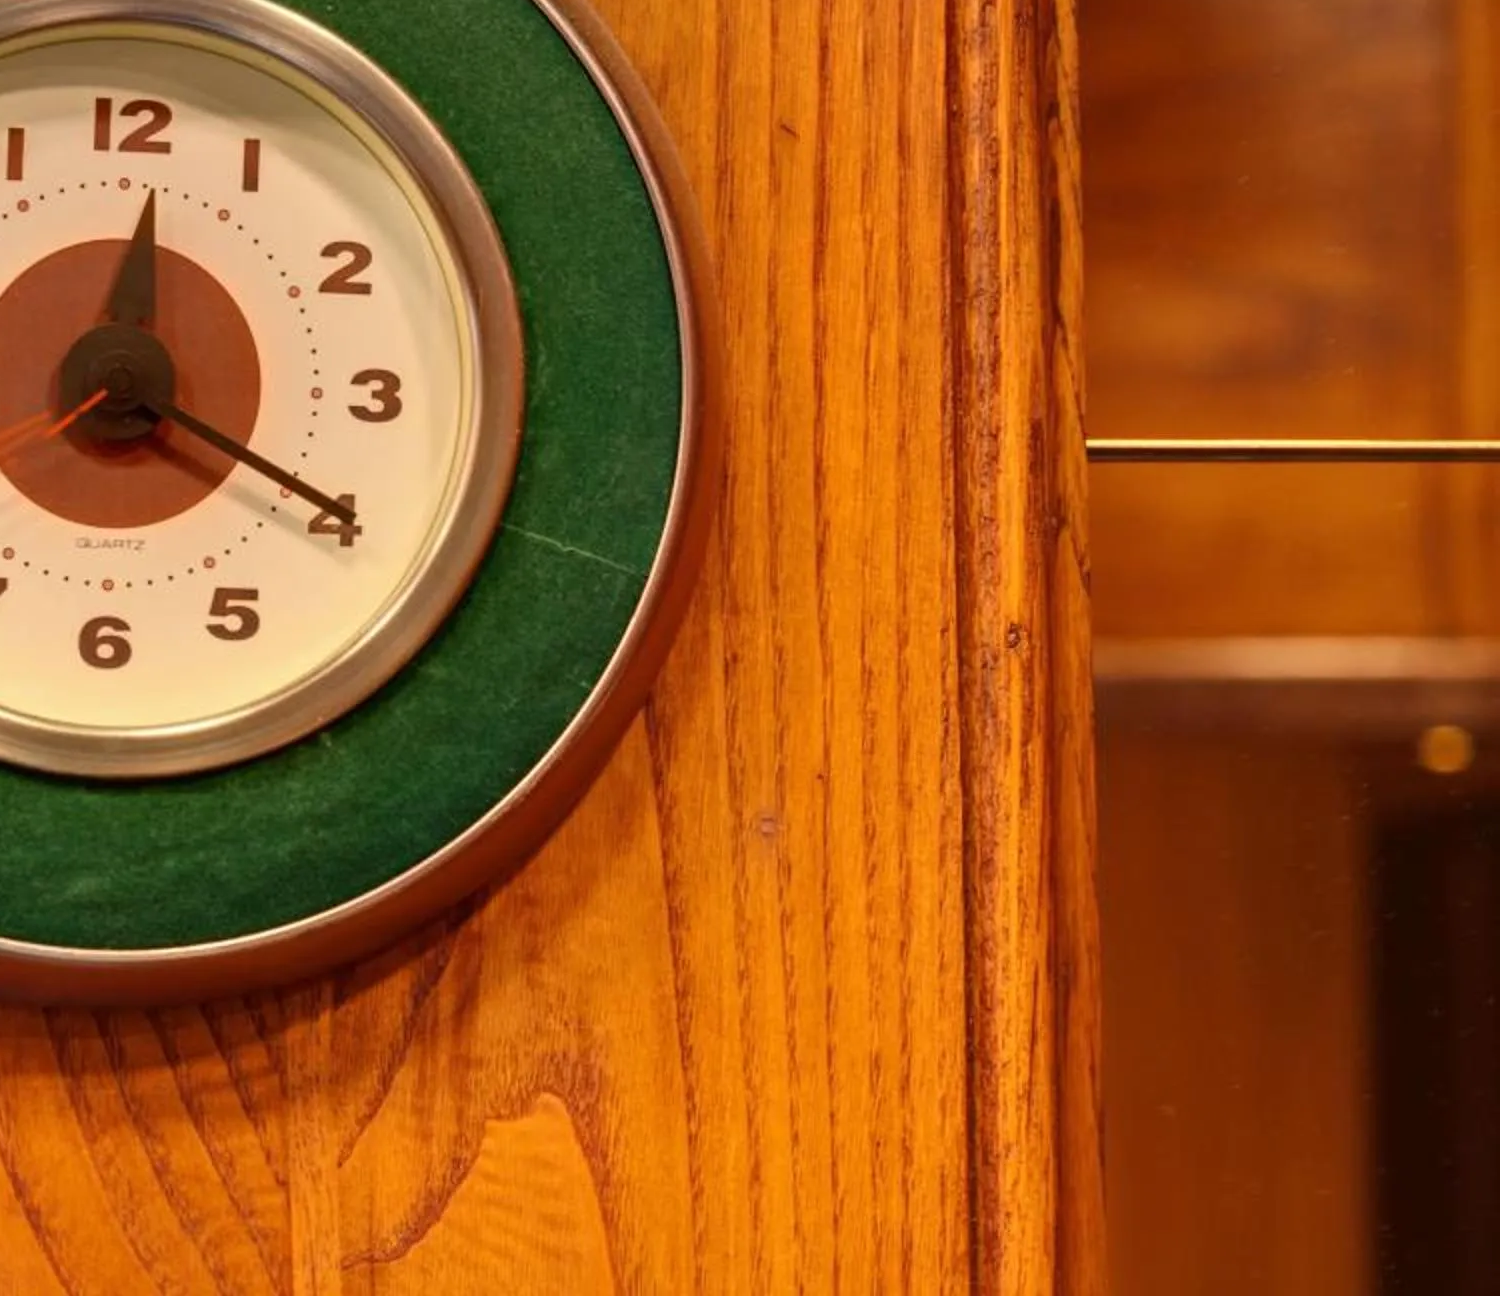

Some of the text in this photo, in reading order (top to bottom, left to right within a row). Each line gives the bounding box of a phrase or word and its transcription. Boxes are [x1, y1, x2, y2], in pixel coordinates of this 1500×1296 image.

[93, 97, 173, 154] 12
[242, 138, 261, 193] 1
[318, 241, 373, 295] 2
[347, 368, 403, 423] 3
[73, 536, 147, 551] QUARTZ
[306, 492, 363, 548] 4
[205, 586, 261, 641] 5
[78, 615, 133, 669] 6
